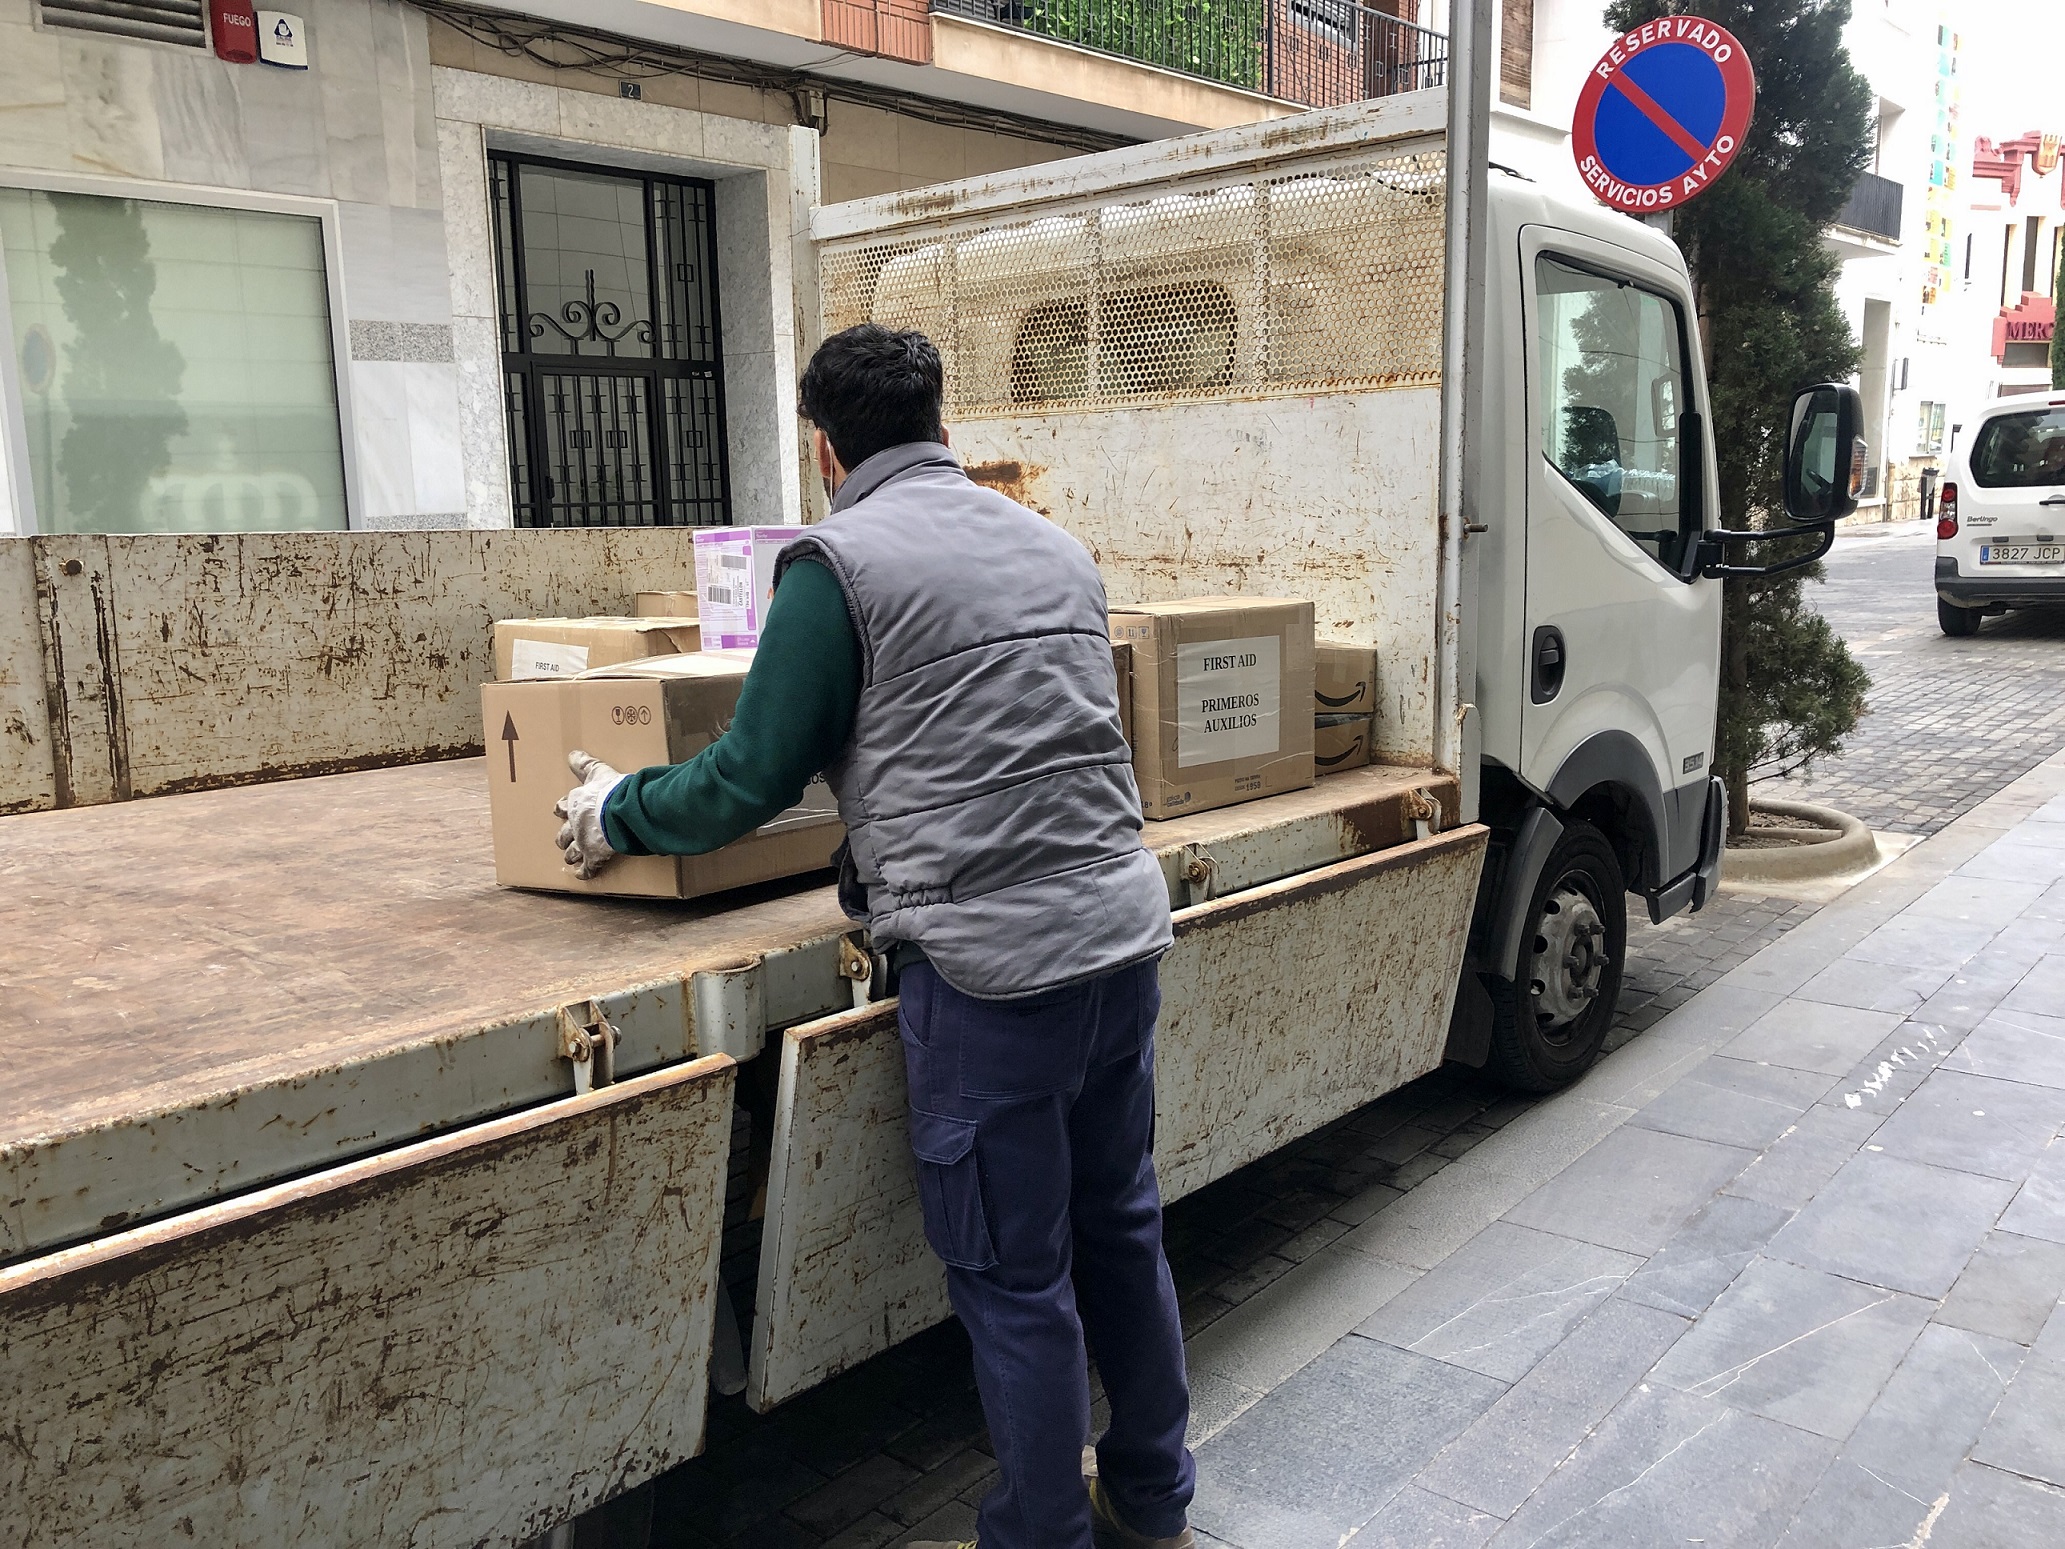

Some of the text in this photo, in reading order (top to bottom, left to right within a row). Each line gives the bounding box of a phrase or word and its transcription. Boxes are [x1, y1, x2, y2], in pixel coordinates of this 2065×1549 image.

[223, 12, 252, 27] FUEGO
[1596, 19, 1732, 80] RESERVADO
[627, 84, 634, 98] 2
[1580, 135, 1735, 207] SERVICIOS AYTO
[1966, 515, 1999, 524] Berlingo
[1992, 547, 2061, 560] 3827 JCP
[535, 661, 560, 672] FIRST AID
[1203, 653, 1257, 671] FIRST AID
[1201, 693, 1260, 713] PRIMEROS
[1204, 713, 1257, 734] AUXILIOS
